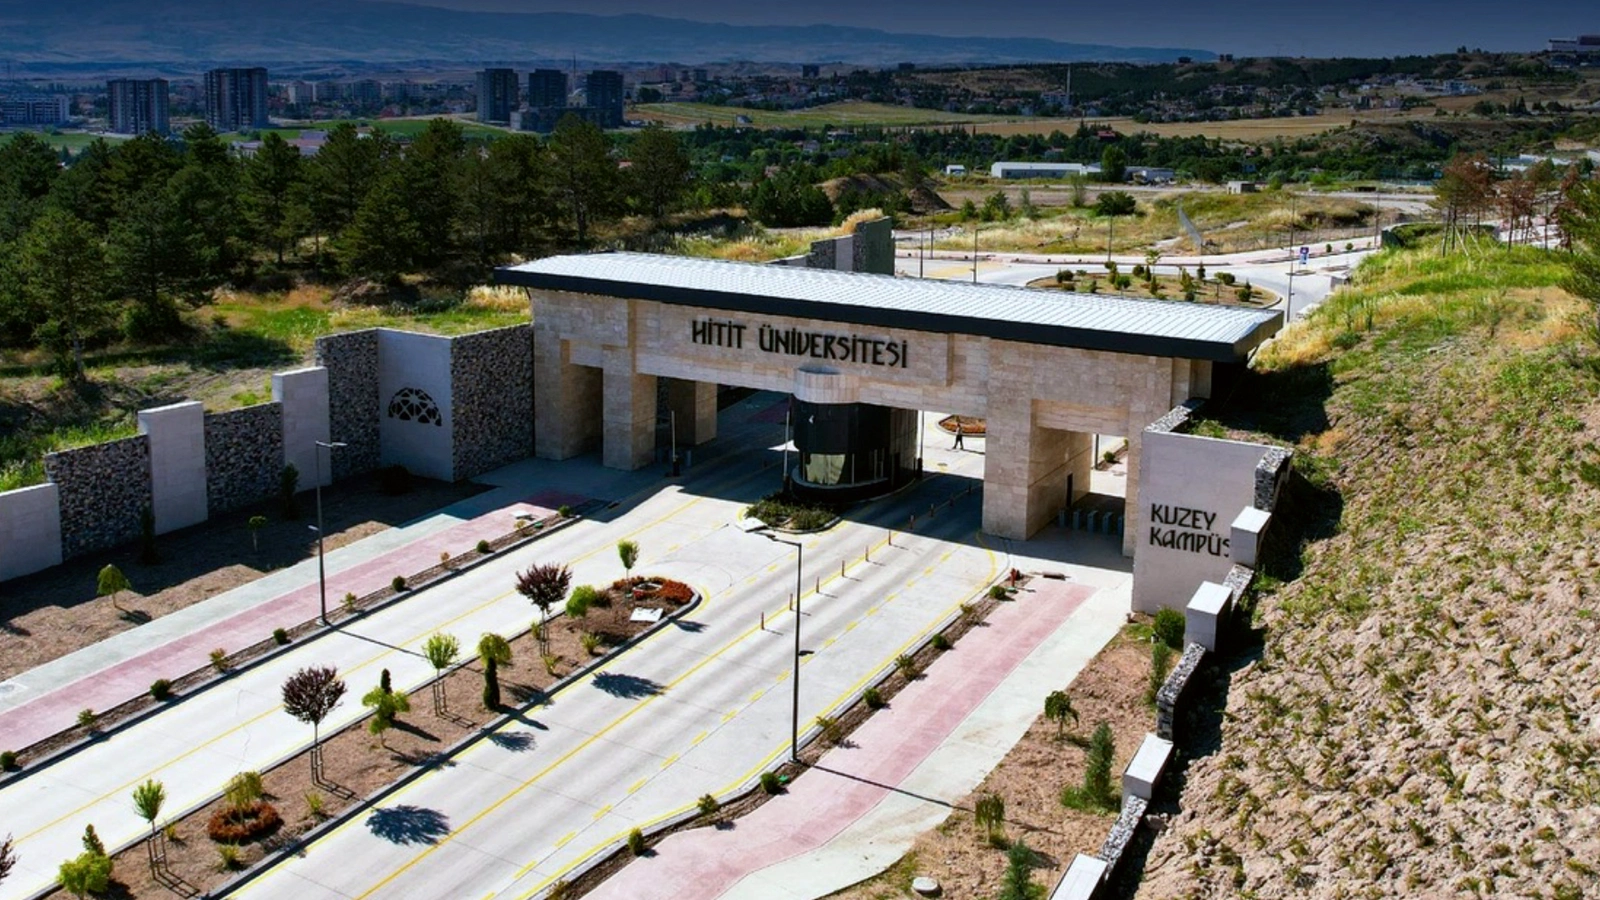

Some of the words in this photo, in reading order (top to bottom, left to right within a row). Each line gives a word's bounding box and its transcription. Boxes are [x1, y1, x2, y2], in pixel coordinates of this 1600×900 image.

[691, 318, 747, 349] HİTİT
[758, 324, 908, 368] ÜNİVERSİTESİ
[1151, 503, 1217, 531] KUZEY
